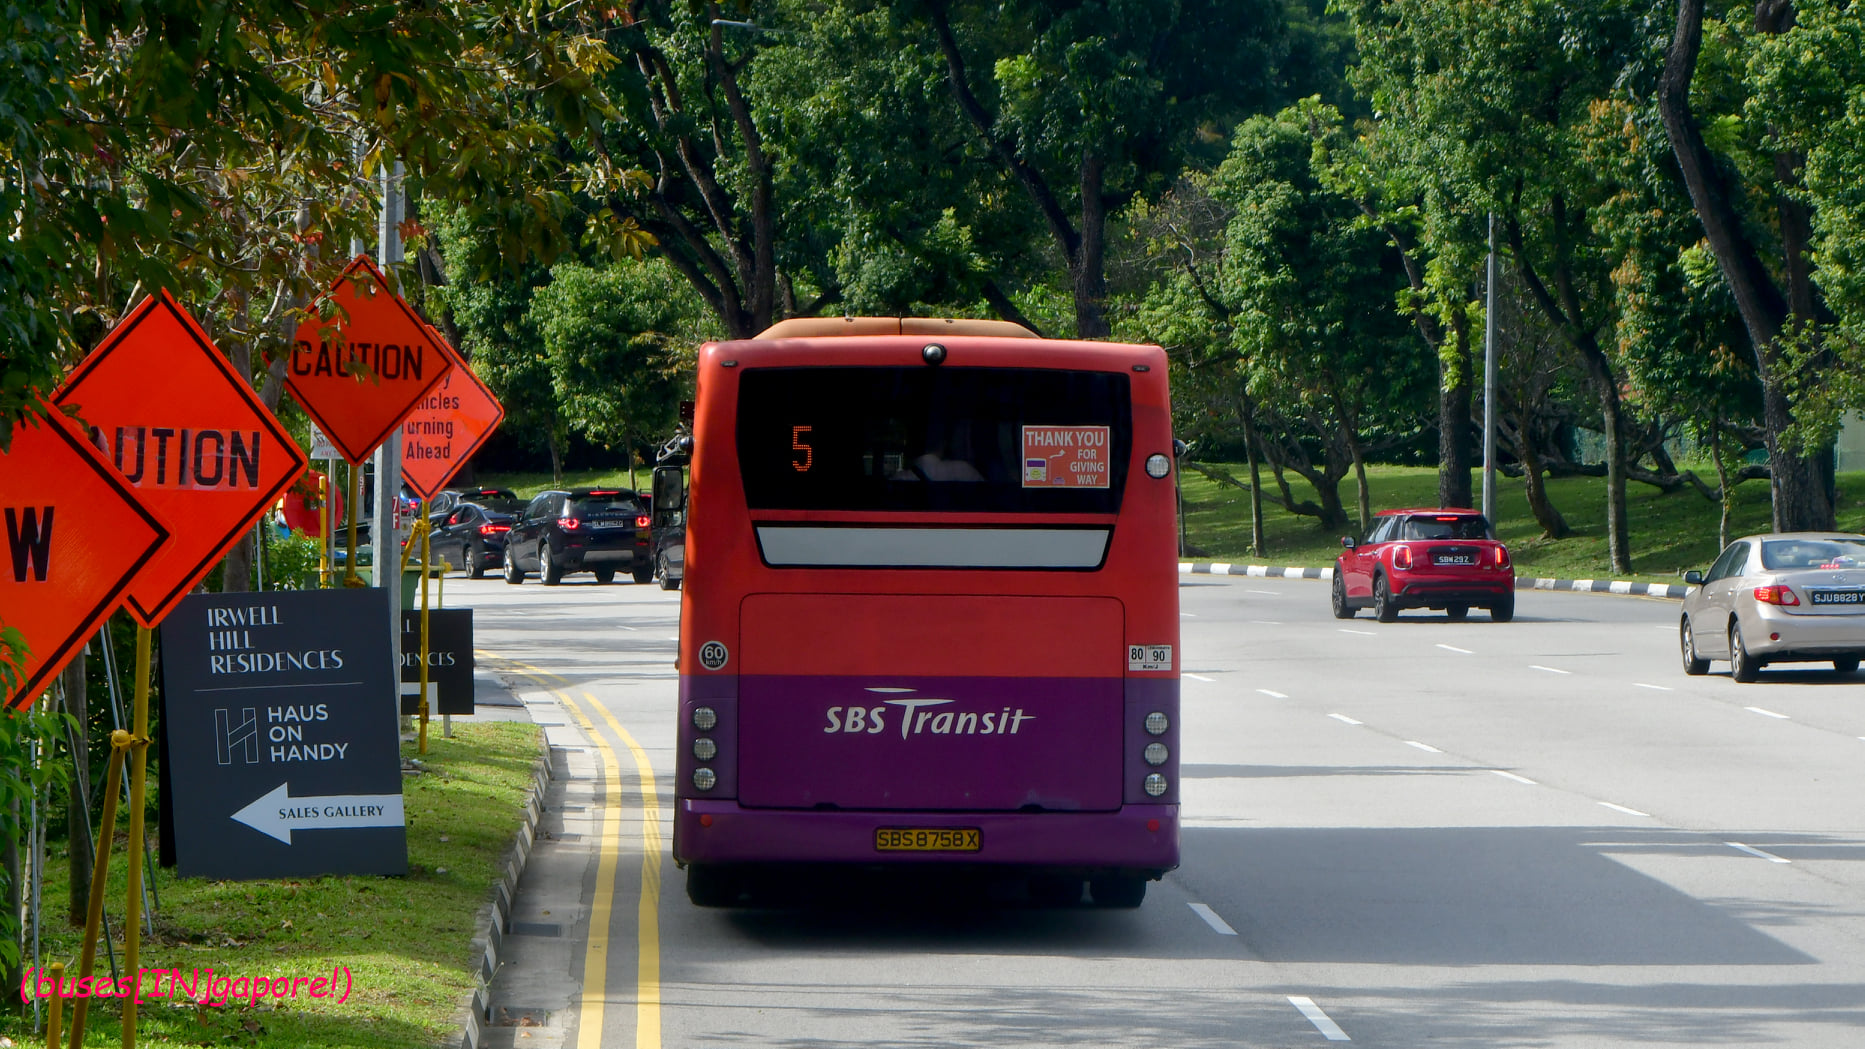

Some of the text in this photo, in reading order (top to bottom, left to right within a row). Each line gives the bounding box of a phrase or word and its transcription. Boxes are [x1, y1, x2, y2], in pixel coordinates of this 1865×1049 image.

[293, 341, 423, 380] CAUTION
[417, 392, 460, 410] icles
[1026, 431, 1104, 447] THANK YOU
[89, 426, 261, 488] UTION
[406, 442, 451, 459] Ahead
[793, 425, 812, 472] 5
[1078, 449, 1097, 460] FOR
[1070, 462, 1105, 473] GIVING
[1077, 475, 1098, 485] WAY
[207, 605, 284, 627] IRWELL
[209, 630, 256, 651] HILL
[210, 649, 344, 674] RESIDENCES
[704, 646, 724, 659] 60
[1131, 648, 1144, 660] 80
[1152, 650, 1165, 661] 90
[267, 703, 329, 723] HAUS
[823, 698, 1037, 741] SBS Transit
[269, 725, 303, 743] ON
[270, 743, 349, 763] HANDY
[278, 805, 385, 820] SALES GALLERY
[877, 831, 978, 848] SBS8758X
